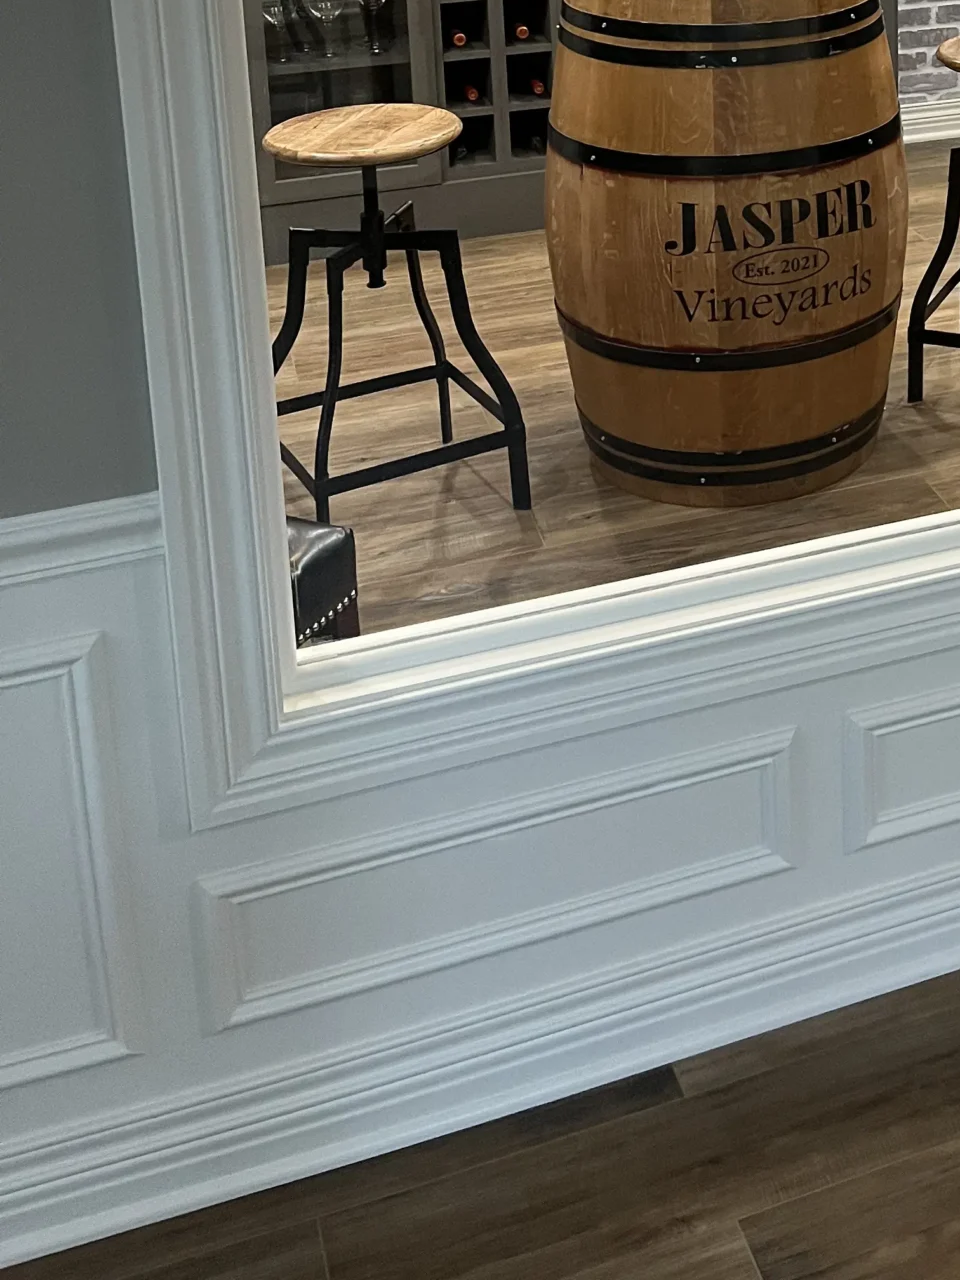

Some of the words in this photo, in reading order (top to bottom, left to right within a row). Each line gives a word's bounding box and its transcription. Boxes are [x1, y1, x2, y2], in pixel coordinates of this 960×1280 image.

[665, 180, 877, 256] JASPER
[674, 263, 871, 326] Vineyards
[743, 262, 775, 279] Est.
[781, 253, 818, 274] 2021
